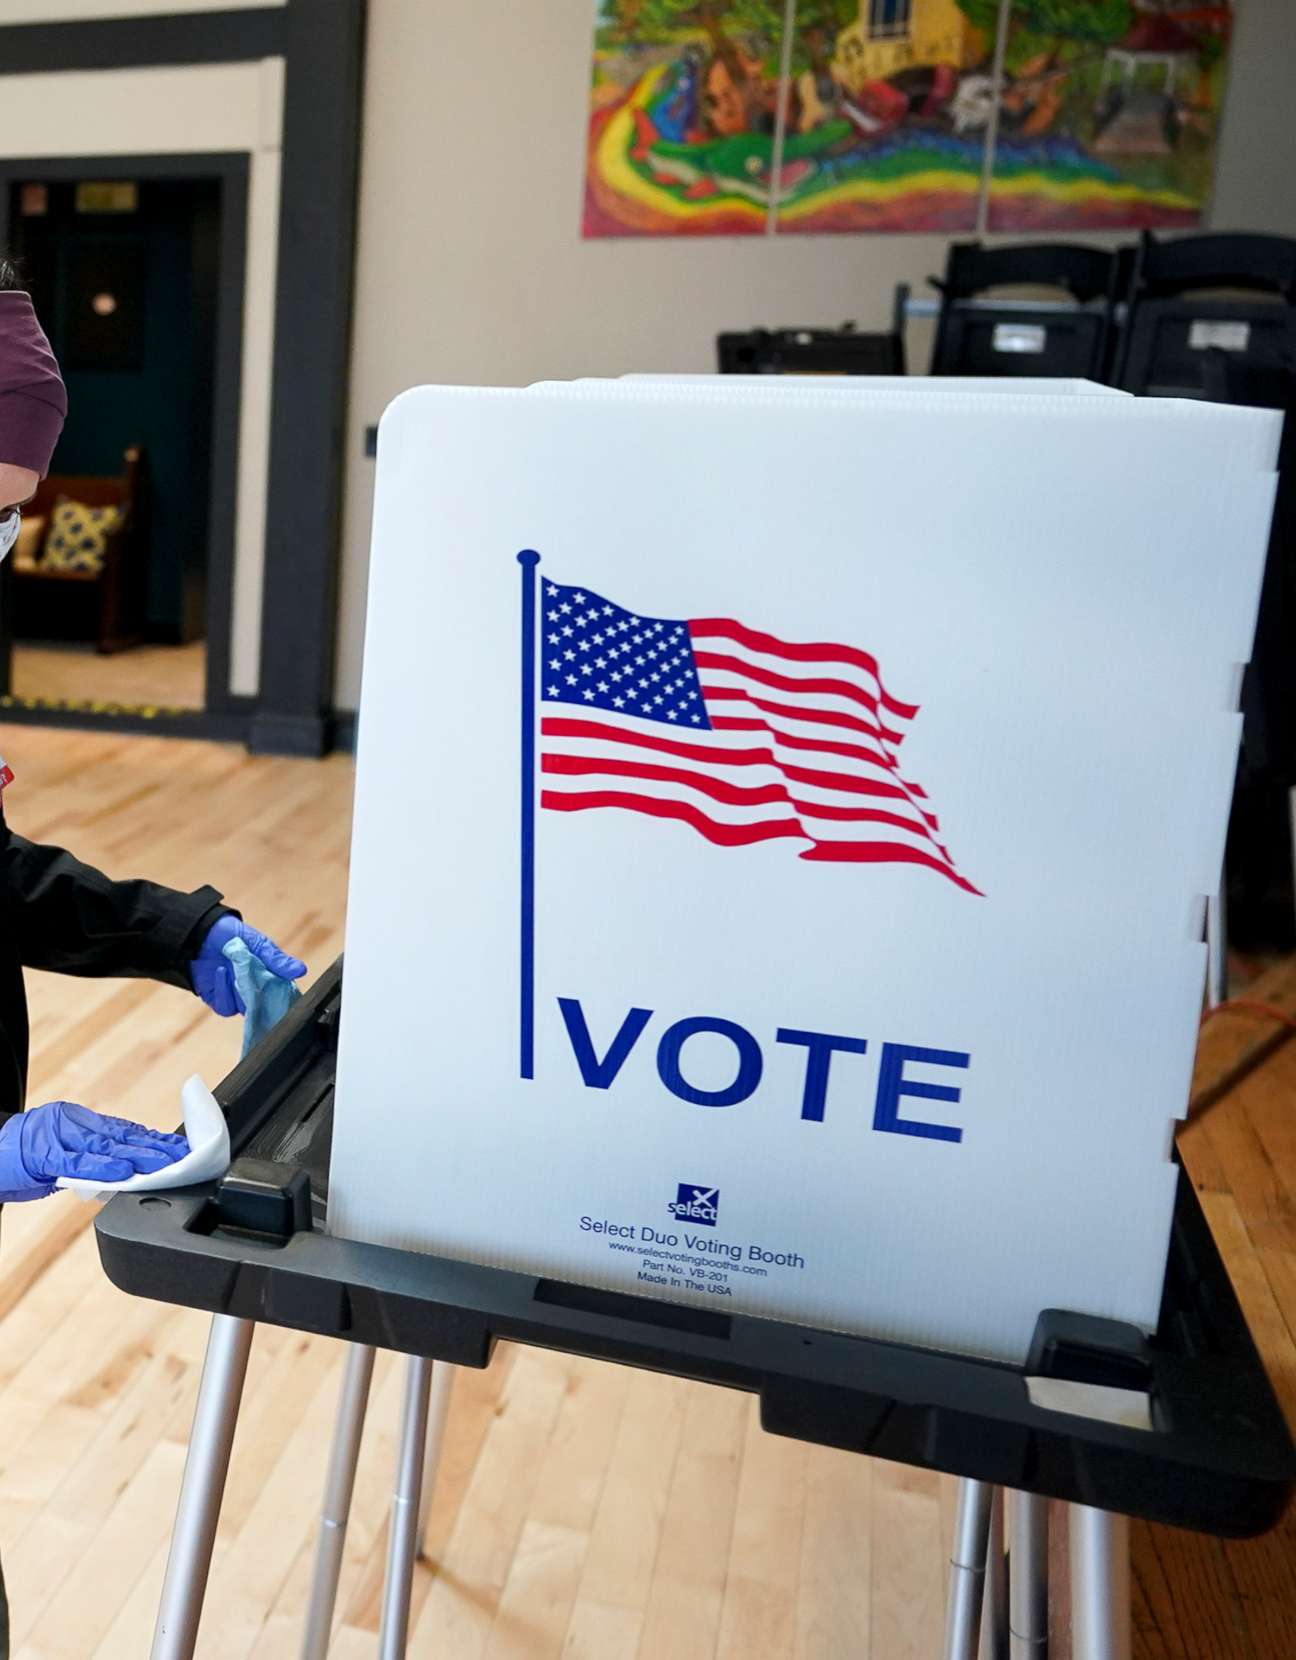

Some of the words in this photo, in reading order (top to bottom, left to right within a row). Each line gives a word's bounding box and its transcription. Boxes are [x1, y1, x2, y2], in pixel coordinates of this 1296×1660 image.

[557, 997, 971, 1144] VOTE
[667, 1199, 719, 1221] select
[579, 1216, 636, 1240] Select
[641, 1226, 678, 1247] Duo
[684, 1233, 743, 1261] Voting
[748, 1245, 806, 1269] Booth
[608, 1241, 768, 1277] www.selectvotingbooths.com
[642, 1259, 665, 1272] Part
[667, 1263, 687, 1275] No.
[689, 1266, 729, 1283] VB-201
[637, 1270, 668, 1285] Made
[670, 1276, 682, 1287] In
[685, 1279, 705, 1292] The
[707, 1284, 733, 1298] USA
